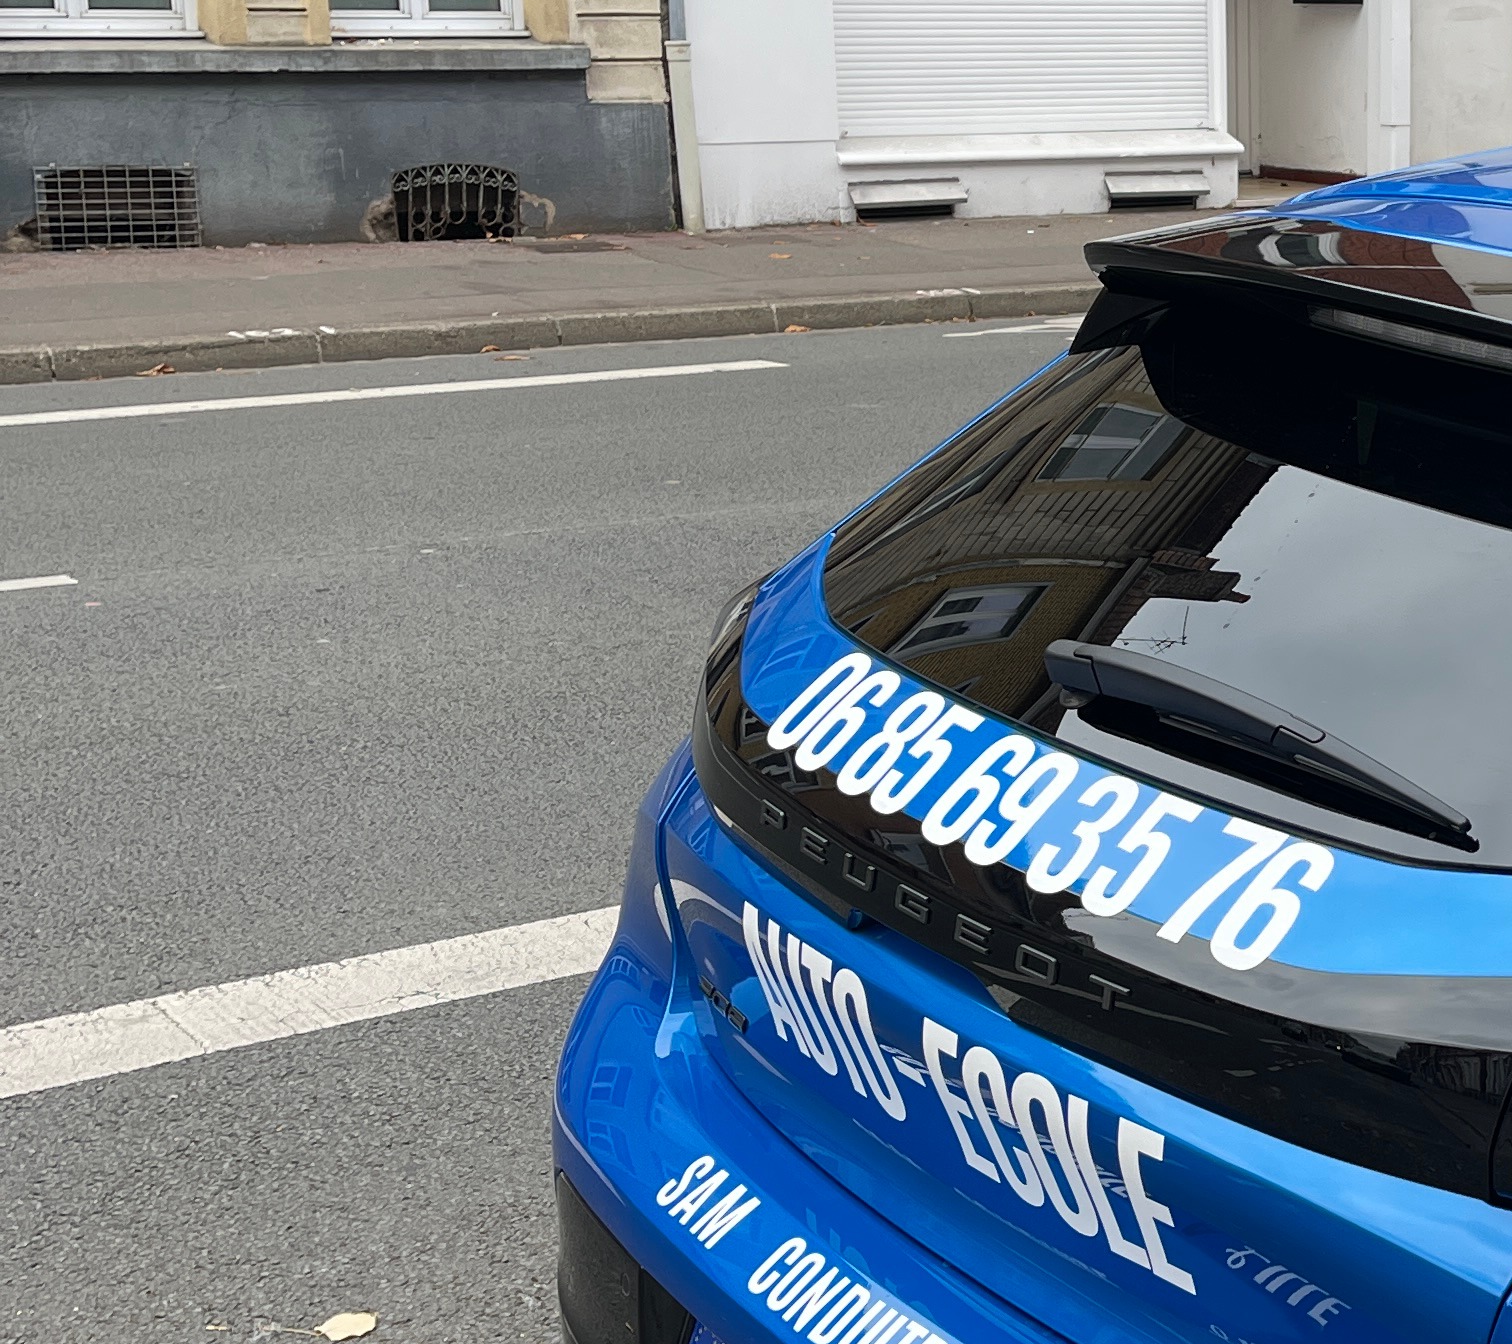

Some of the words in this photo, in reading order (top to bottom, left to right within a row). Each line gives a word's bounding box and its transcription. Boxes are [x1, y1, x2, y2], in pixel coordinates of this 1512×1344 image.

[758, 798, 1132, 1011] PEUGEOT
[767, 652, 902, 771] 06
[836, 690, 985, 815] 85
[921, 734, 1079, 867] 69
[1025, 775, 1204, 917] 35
[1156, 816, 1335, 971] 76
[656, 1155, 761, 1250] SAM
[742, 900, 1198, 1296] AUTO-ECOLE
